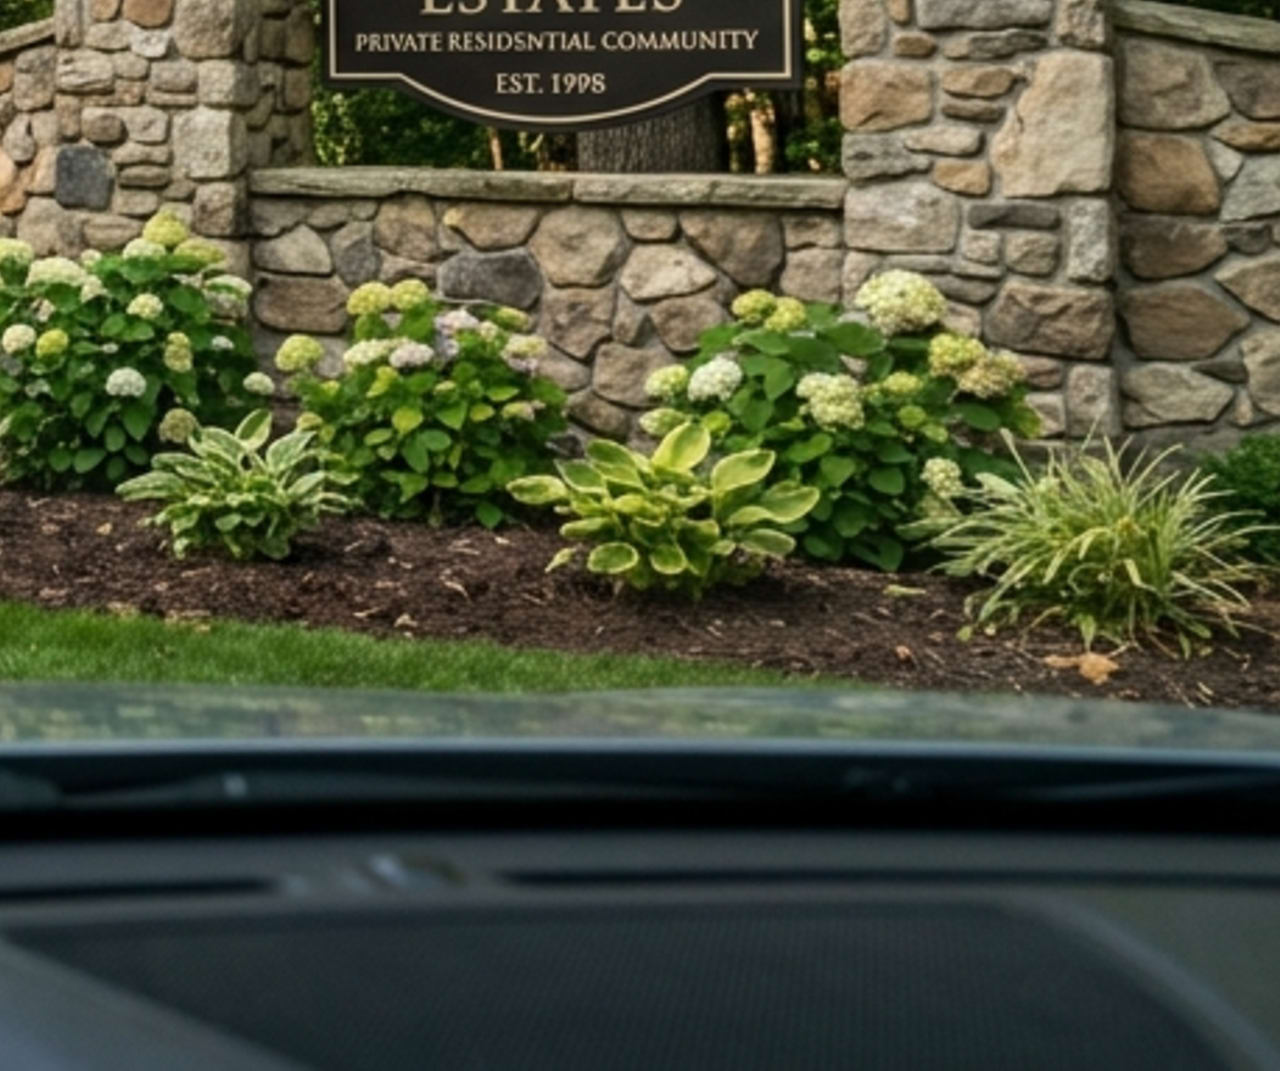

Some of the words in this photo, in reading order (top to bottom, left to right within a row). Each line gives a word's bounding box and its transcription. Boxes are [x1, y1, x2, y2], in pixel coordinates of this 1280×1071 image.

[355, 32, 443, 53] PRIVATE
[600, 29, 759, 51] COMMUNITY
[496, 72, 544, 95] EST.
